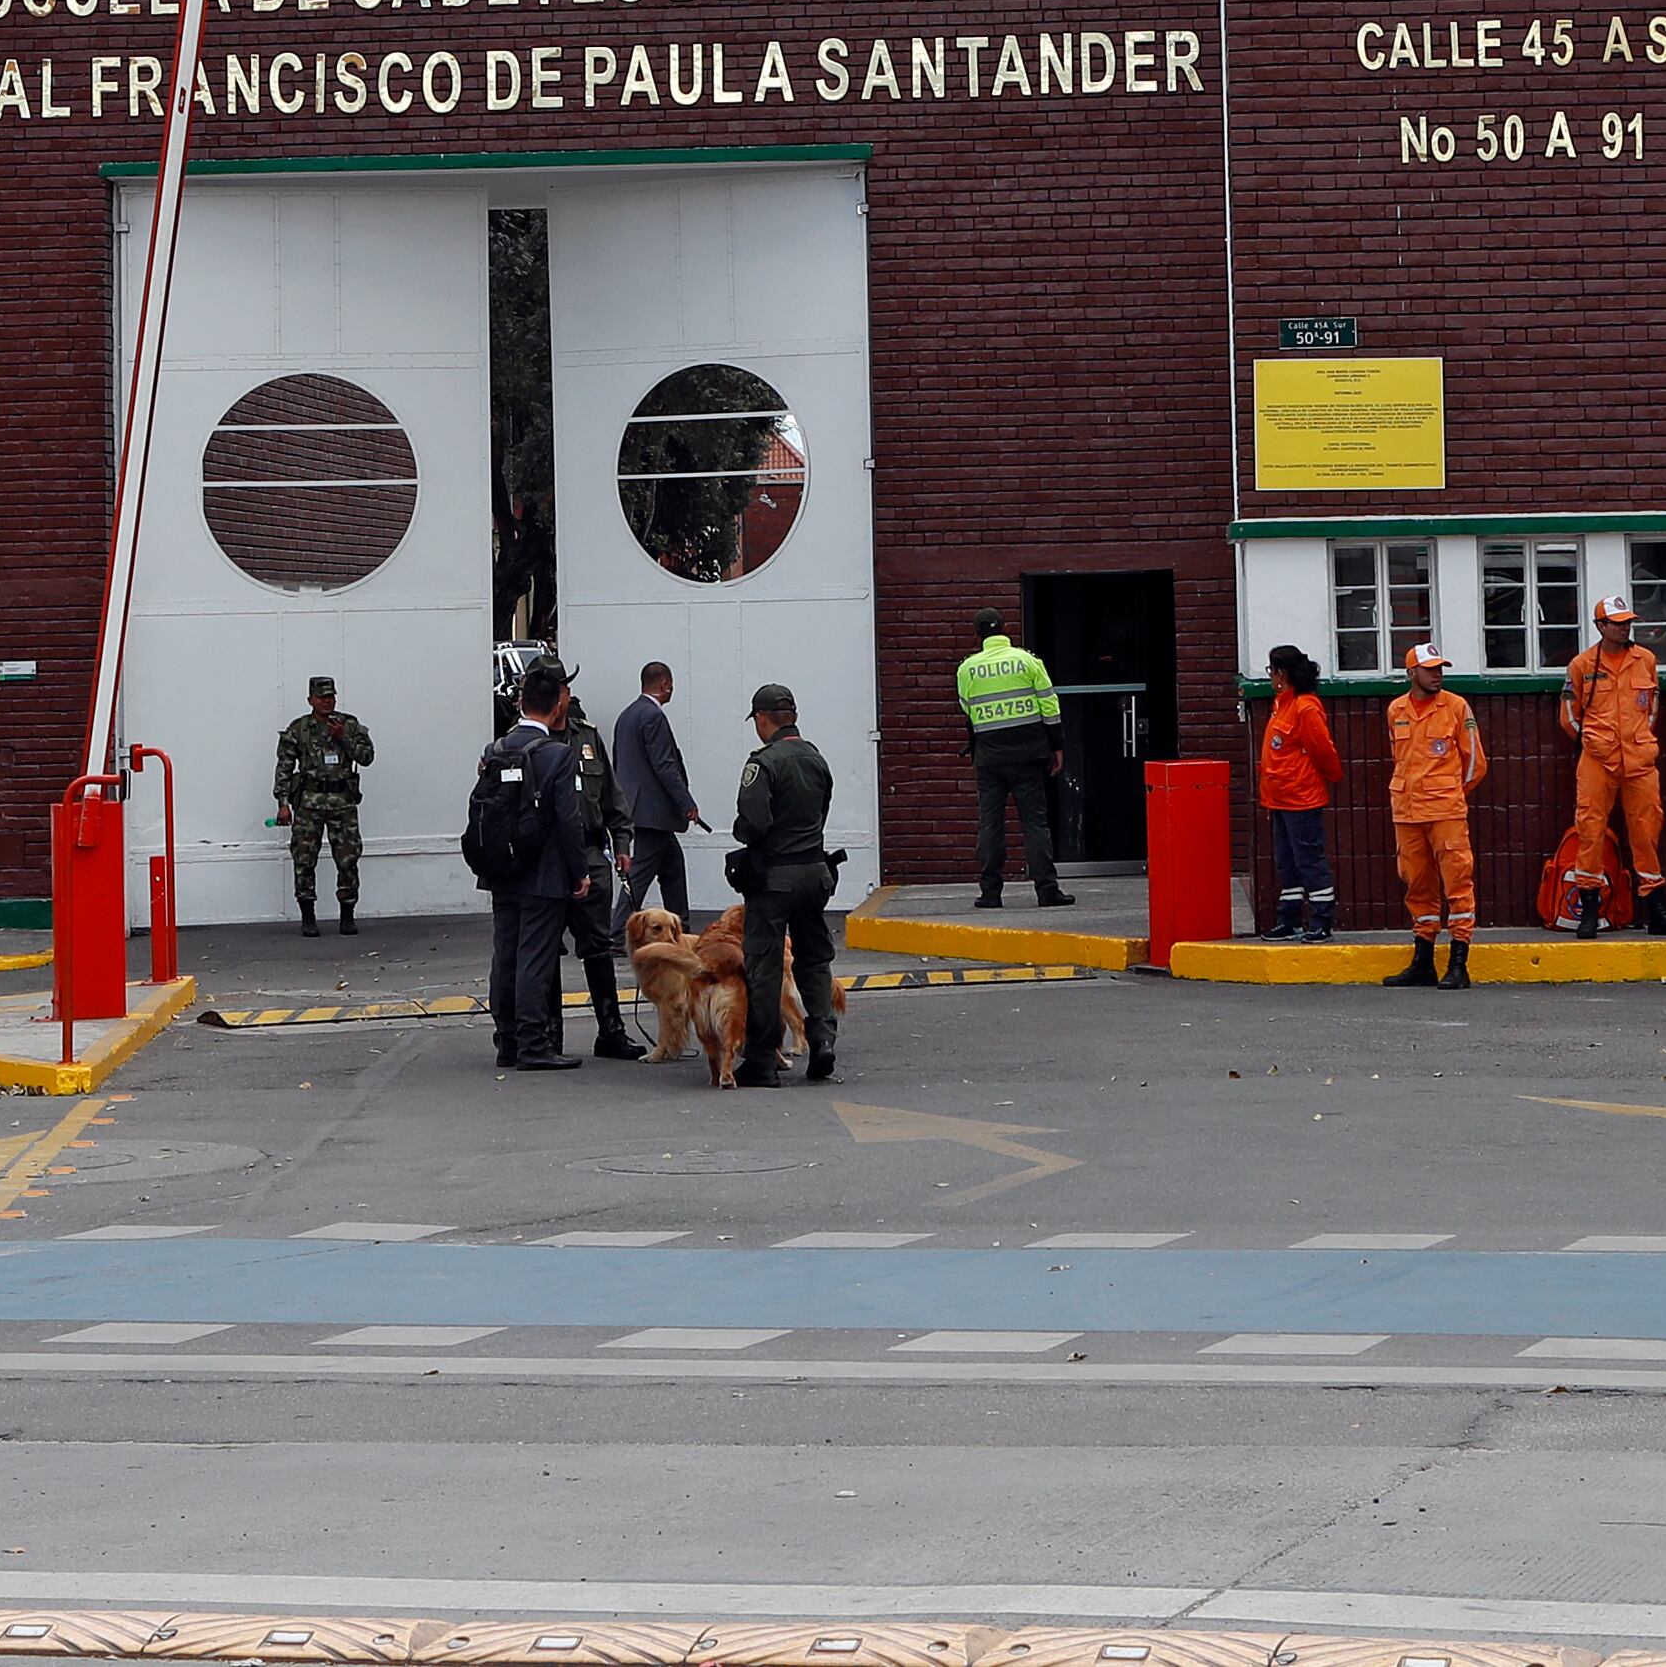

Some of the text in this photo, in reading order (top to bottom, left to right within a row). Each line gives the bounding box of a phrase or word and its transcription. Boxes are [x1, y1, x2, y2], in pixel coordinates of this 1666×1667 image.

[1356, 19, 1504, 70] CALLE
[1522, 19, 1574, 66] 45
[1602, 16, 1634, 63] A
[486, 47, 564, 111] DE
[584, 42, 795, 107] PAULA
[815, 30, 1205, 102] SANTANDER
[1400, 111, 1644, 164] No 50 A 91
[1288, 320, 1347, 330] Calle 45A Sur
[968, 659, 1027, 680] POLICIA
[975, 698, 1034, 721] 254759
